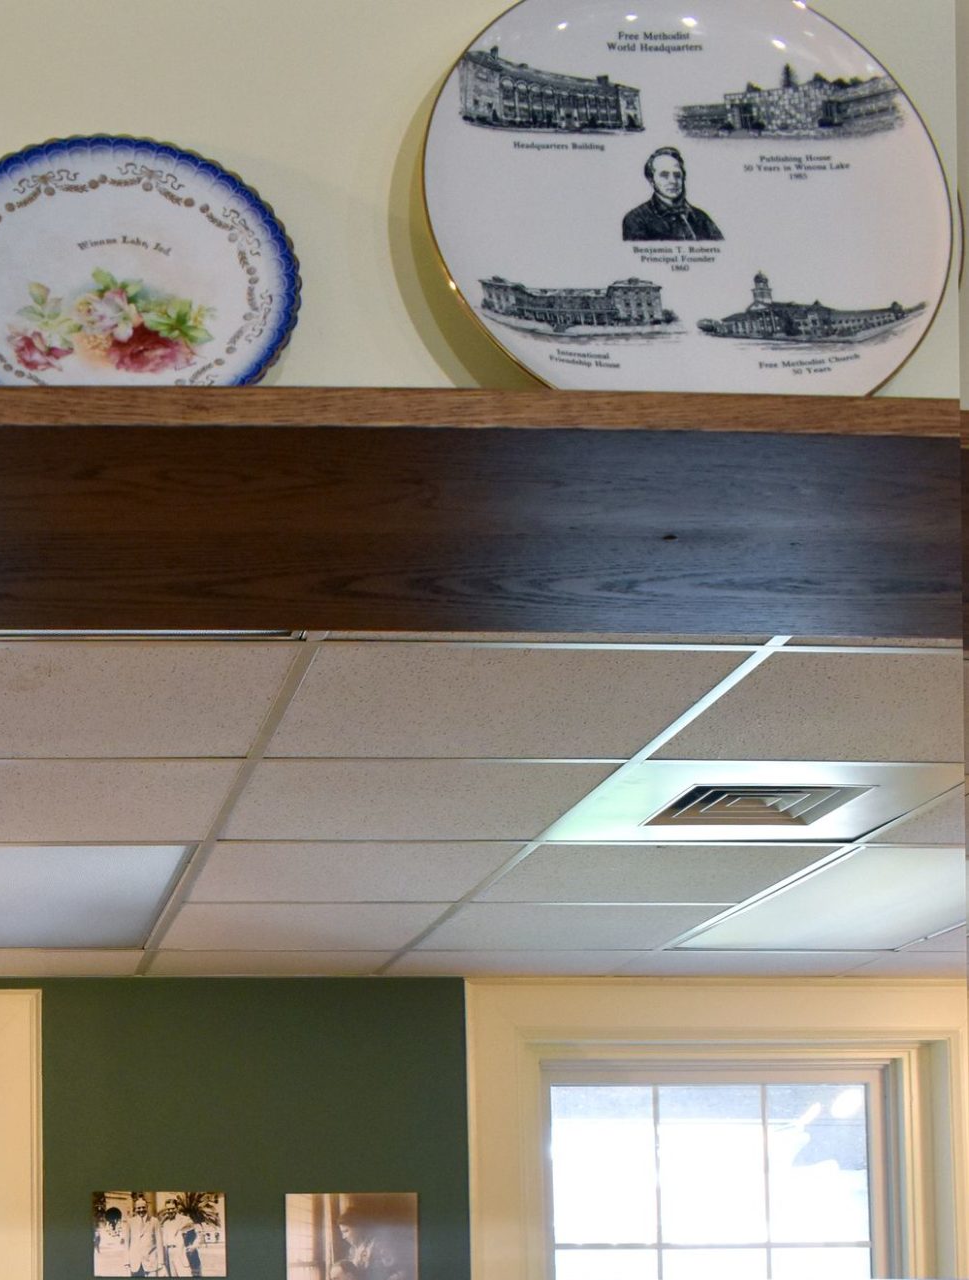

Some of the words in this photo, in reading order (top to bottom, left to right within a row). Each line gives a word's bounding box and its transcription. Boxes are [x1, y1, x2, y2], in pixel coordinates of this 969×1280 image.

[618, 31, 639, 40] Free
[643, 31, 690, 40] Methodist
[607, 42, 636, 52] World
[640, 43, 703, 53] Headquarters
[513, 141, 568, 151] Headquarters
[571, 142, 605, 152] Building
[759, 155, 802, 163] Publishing
[829, 162, 850, 170] Lake
[633, 246, 673, 254] Benjamin
[688, 246, 720, 254] Roberts
[640, 255, 678, 264] Principal
[681, 255, 715, 263] Founder
[557, 348, 610, 360] International
[549, 354, 592, 368] Friendship
[594, 360, 621, 369] House
[758, 361, 778, 369] Free
[782, 358, 825, 368] Methodist
[828, 353, 860, 363] Church
[806, 366, 832, 374] Years
